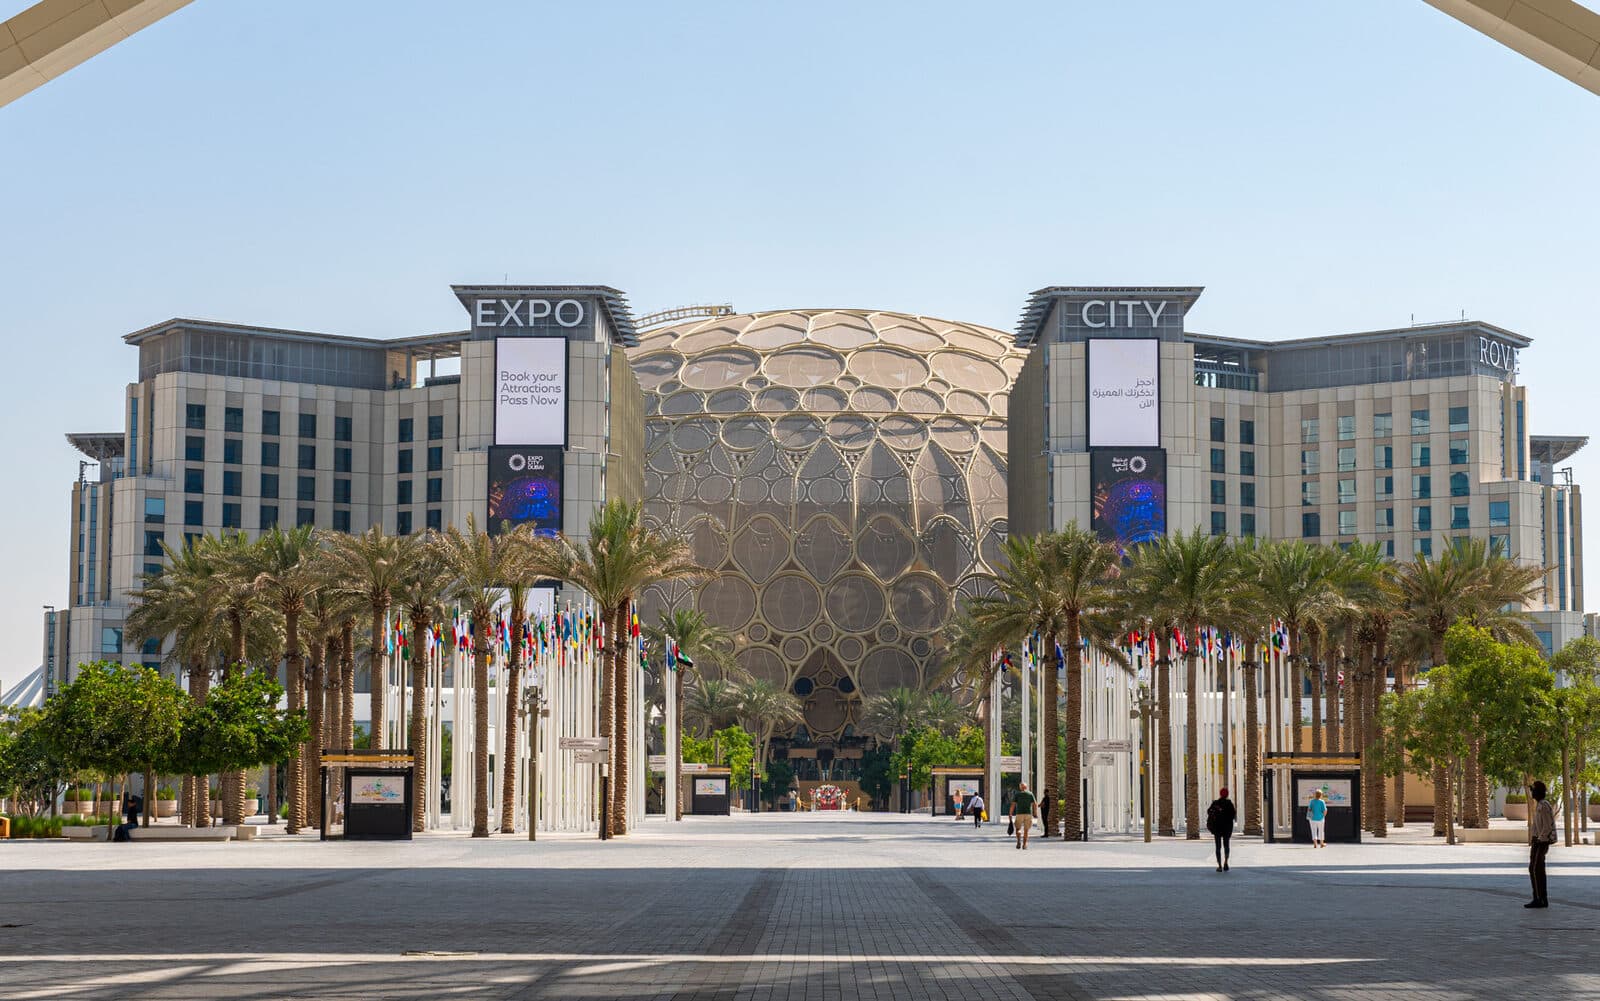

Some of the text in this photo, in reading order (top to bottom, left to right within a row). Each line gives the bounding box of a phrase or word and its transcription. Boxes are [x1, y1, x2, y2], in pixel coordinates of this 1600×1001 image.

[476, 299, 584, 328] EXPO
[1082, 299, 1167, 328] CITY
[1479, 336, 1521, 375] ROVE
[500, 370, 558, 384] Book your
[1135, 377, 1155, 388] احجز
[500, 382, 561, 393] Attractions
[500, 394, 559, 405] Pass Now
